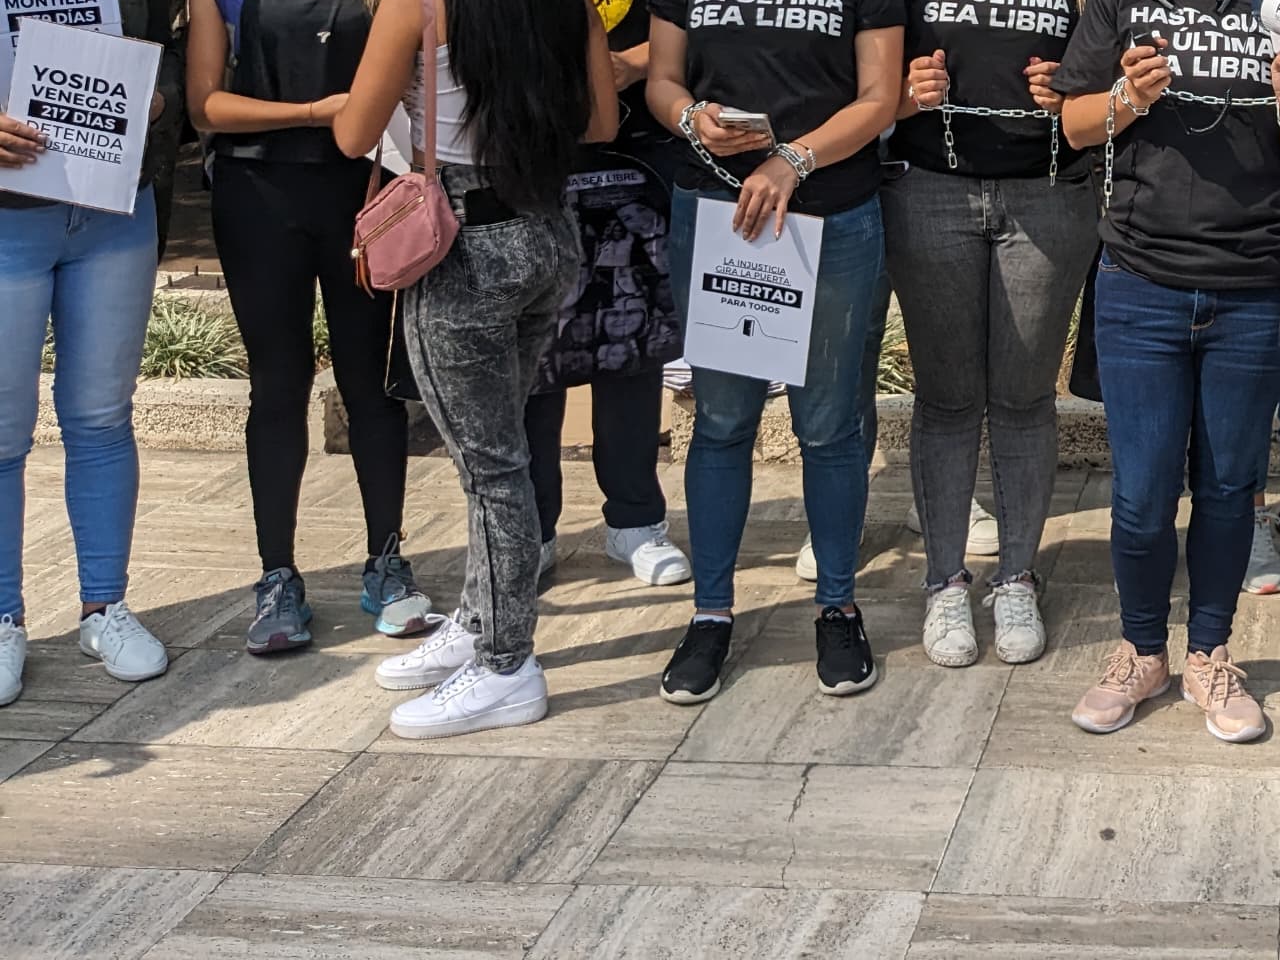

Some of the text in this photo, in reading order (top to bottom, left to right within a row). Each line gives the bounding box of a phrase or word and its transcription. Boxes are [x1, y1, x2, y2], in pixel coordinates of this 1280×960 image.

[56, 9, 96, 25] DÍAS
[690, 4, 844, 37] SEA LIBRE
[923, 1, 1071, 39] SEA LIBRE
[1130, 6, 1217, 27] HASTA
[33, 64, 128, 100] YOSIDA
[1192, 55, 1272, 85] LIBRE
[31, 83, 127, 115] VENEGAS
[40, 104, 117, 131] 217 DÍAS
[43, 138, 123, 164] USTAMENTE
[723, 257, 787, 276] LA INJUSTICIA
[740, 269, 751, 279] LA
[711, 277, 798, 305] LIBERTAD
[720, 297, 781, 315] PARA TODOS
